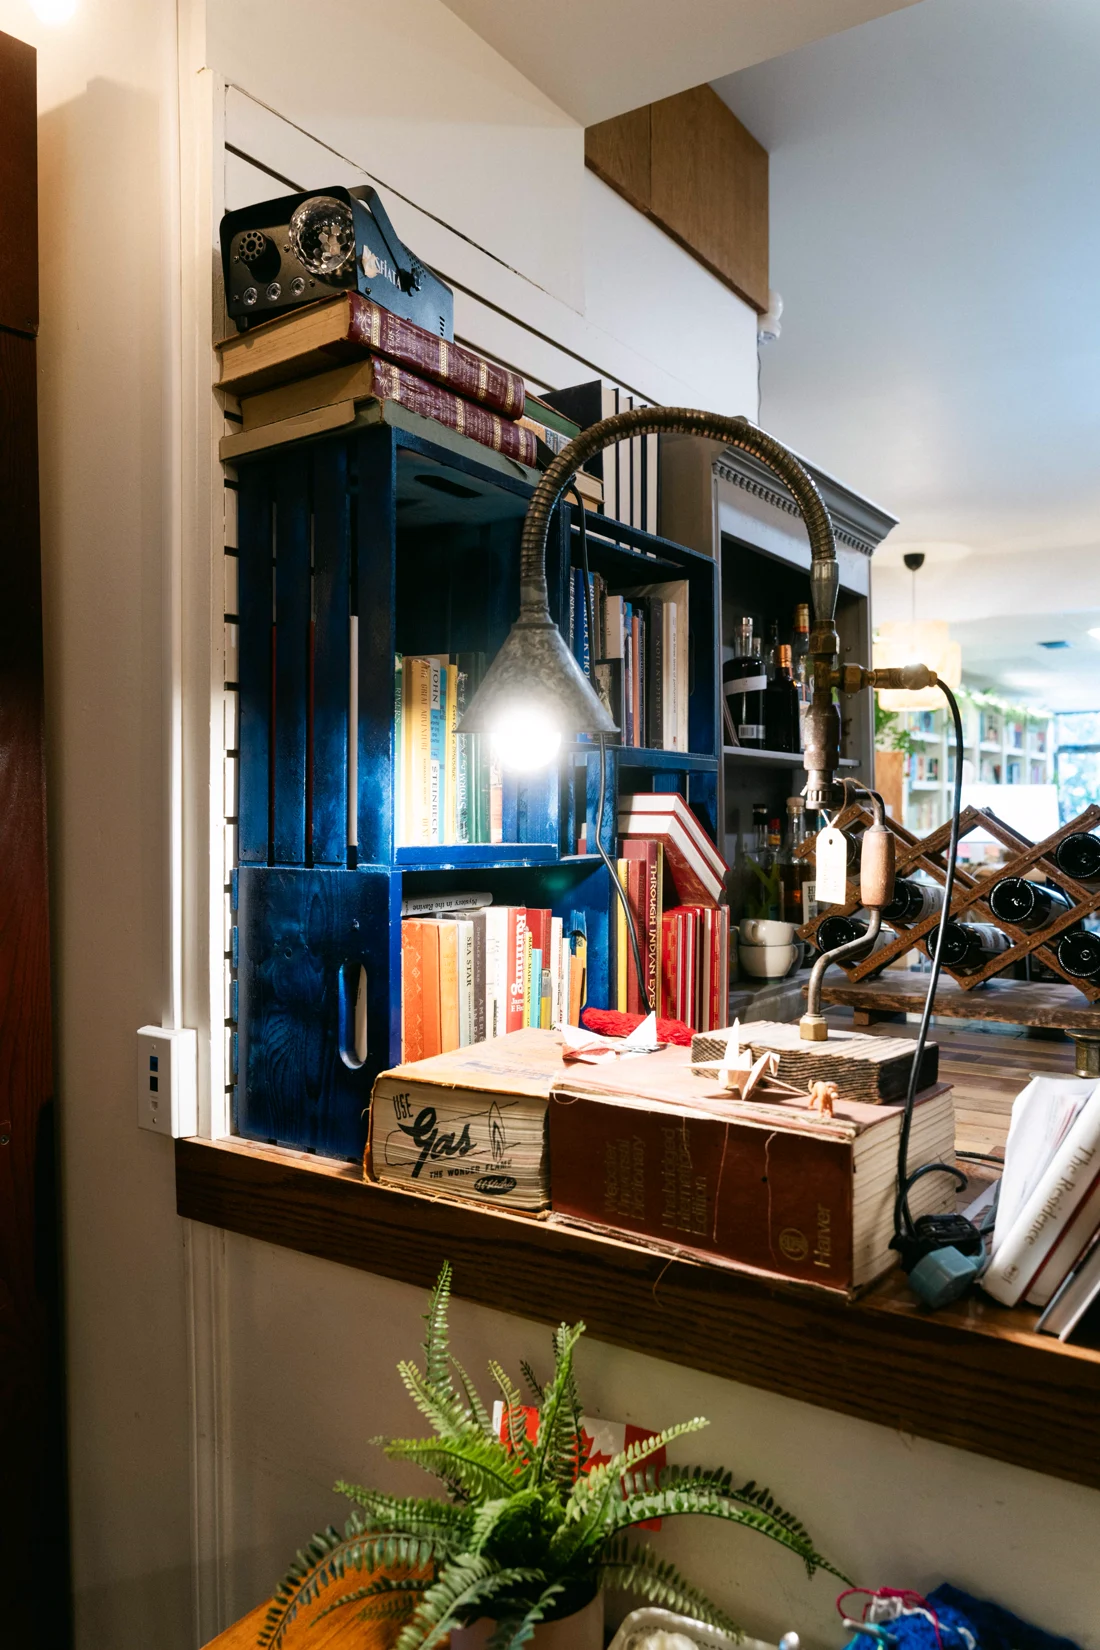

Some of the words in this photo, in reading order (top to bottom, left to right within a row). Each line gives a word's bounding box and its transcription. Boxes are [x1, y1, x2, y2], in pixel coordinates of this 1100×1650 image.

[459, 772, 467, 810] STORM
[412, 903, 434, 912] Ravine
[435, 902, 445, 910] the
[455, 898, 478, 906] Mystery
[649, 862, 658, 924] THROUGH
[511, 914, 527, 996] Running
[647, 981, 656, 1009] EYES
[393, 1093, 413, 1120] USE
[397, 1107, 477, 1178] Gas
[429, 1171, 443, 1179] THE
[447, 1165, 480, 1177] WONDER
[485, 1158, 513, 1172] FLAME
[1065, 1145, 1096, 1174] The
[604, 1140, 617, 1213] Webster
[616, 1138, 630, 1217] Universal
[630, 1134, 645, 1221] Dictionary
[661, 1127, 678, 1229] Unabridged
[676, 1127, 691, 1233] International
[691, 1175, 707, 1237] Edition
[813, 1202, 831, 1268] Harver
[1024, 1176, 1076, 1246] Residence
